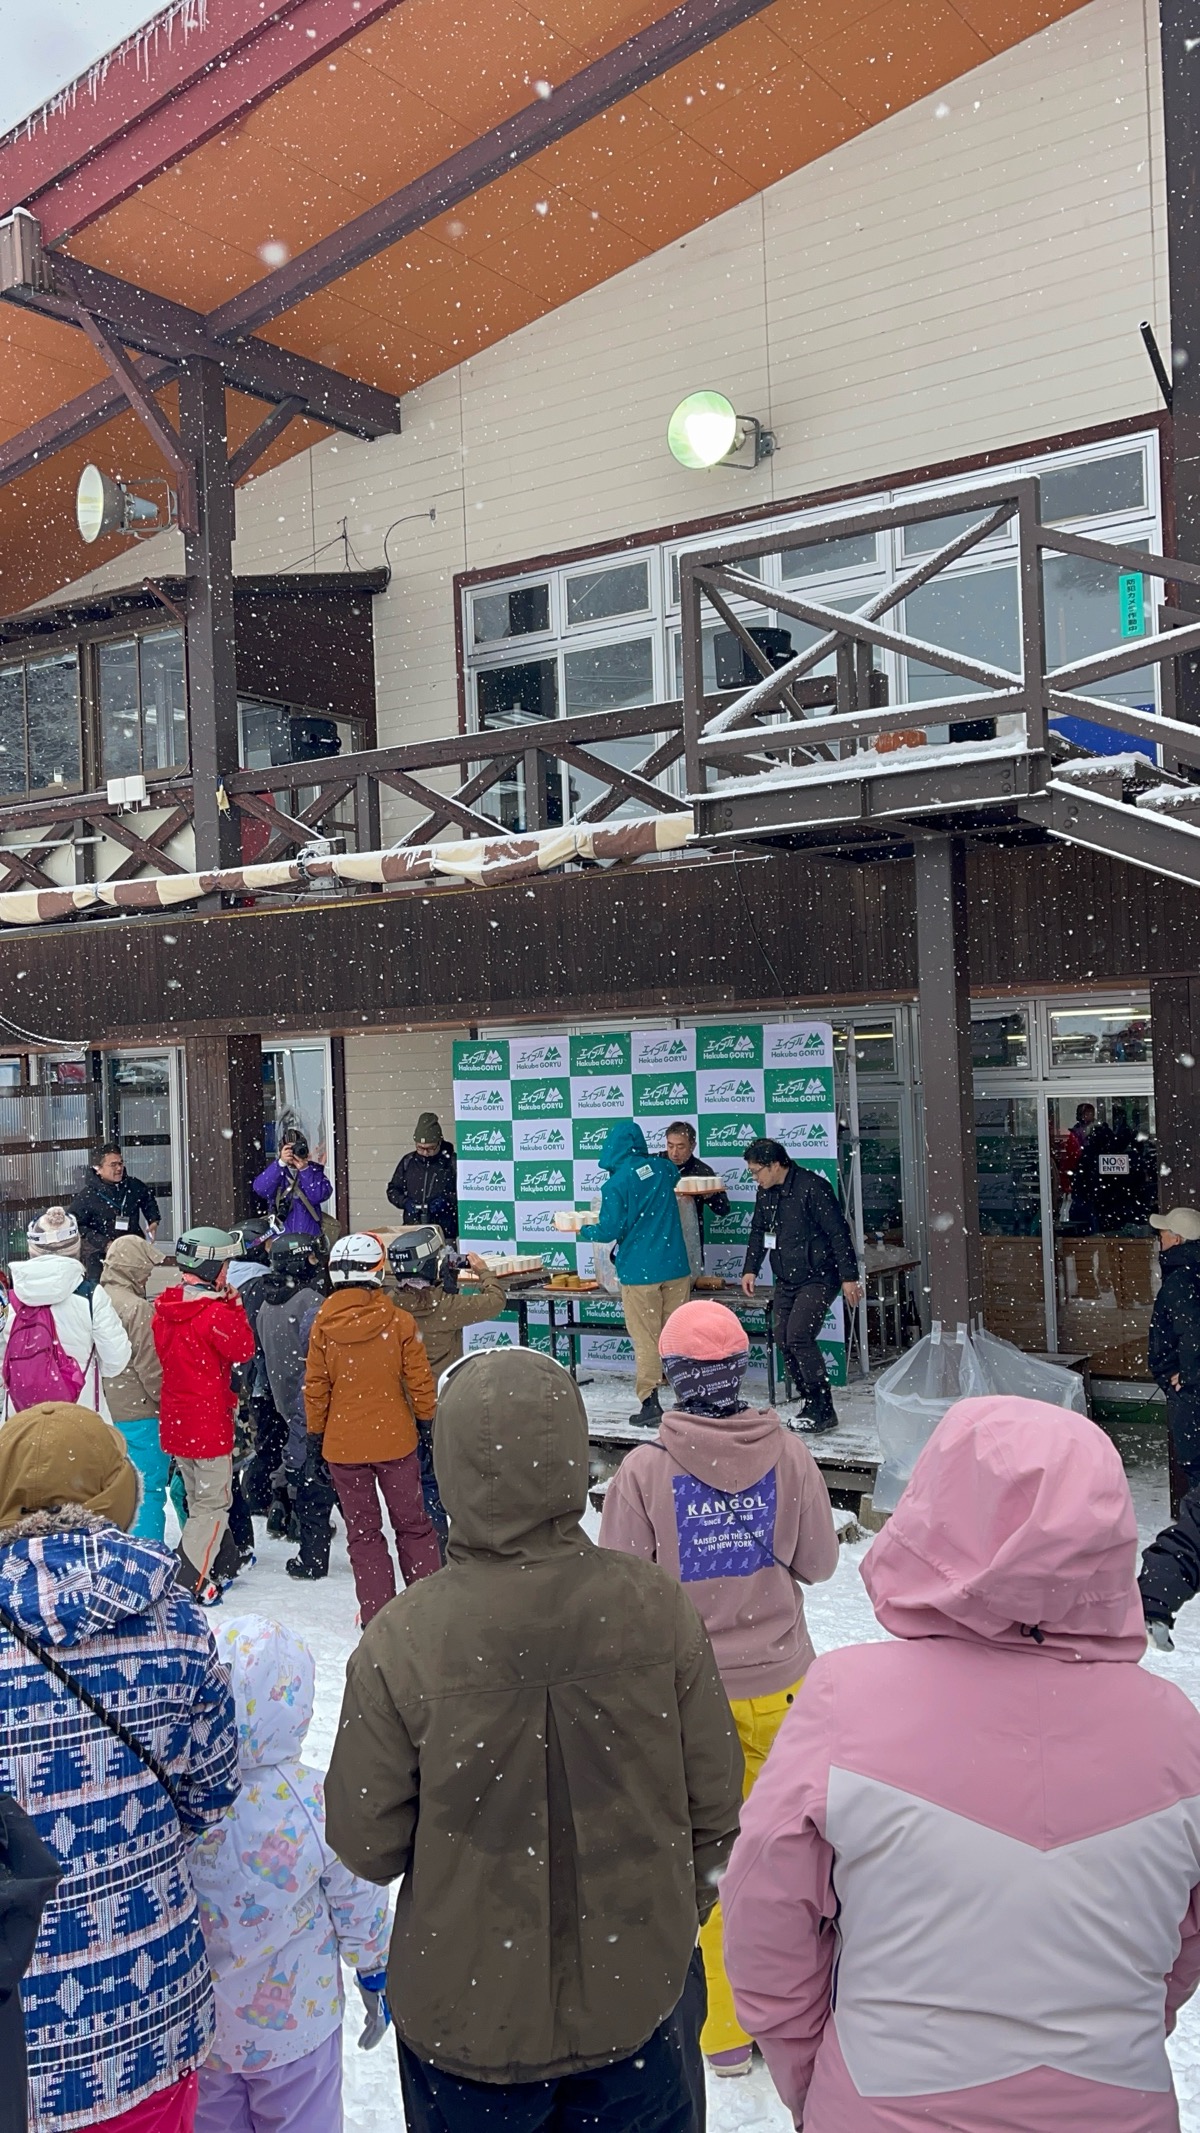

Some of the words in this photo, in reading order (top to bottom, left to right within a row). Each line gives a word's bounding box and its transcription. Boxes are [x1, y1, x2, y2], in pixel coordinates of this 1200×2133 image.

[688, 1496, 766, 1515] KANGOL
[694, 1536, 716, 1545] RAISED
[717, 1541, 732, 1549] NEW
